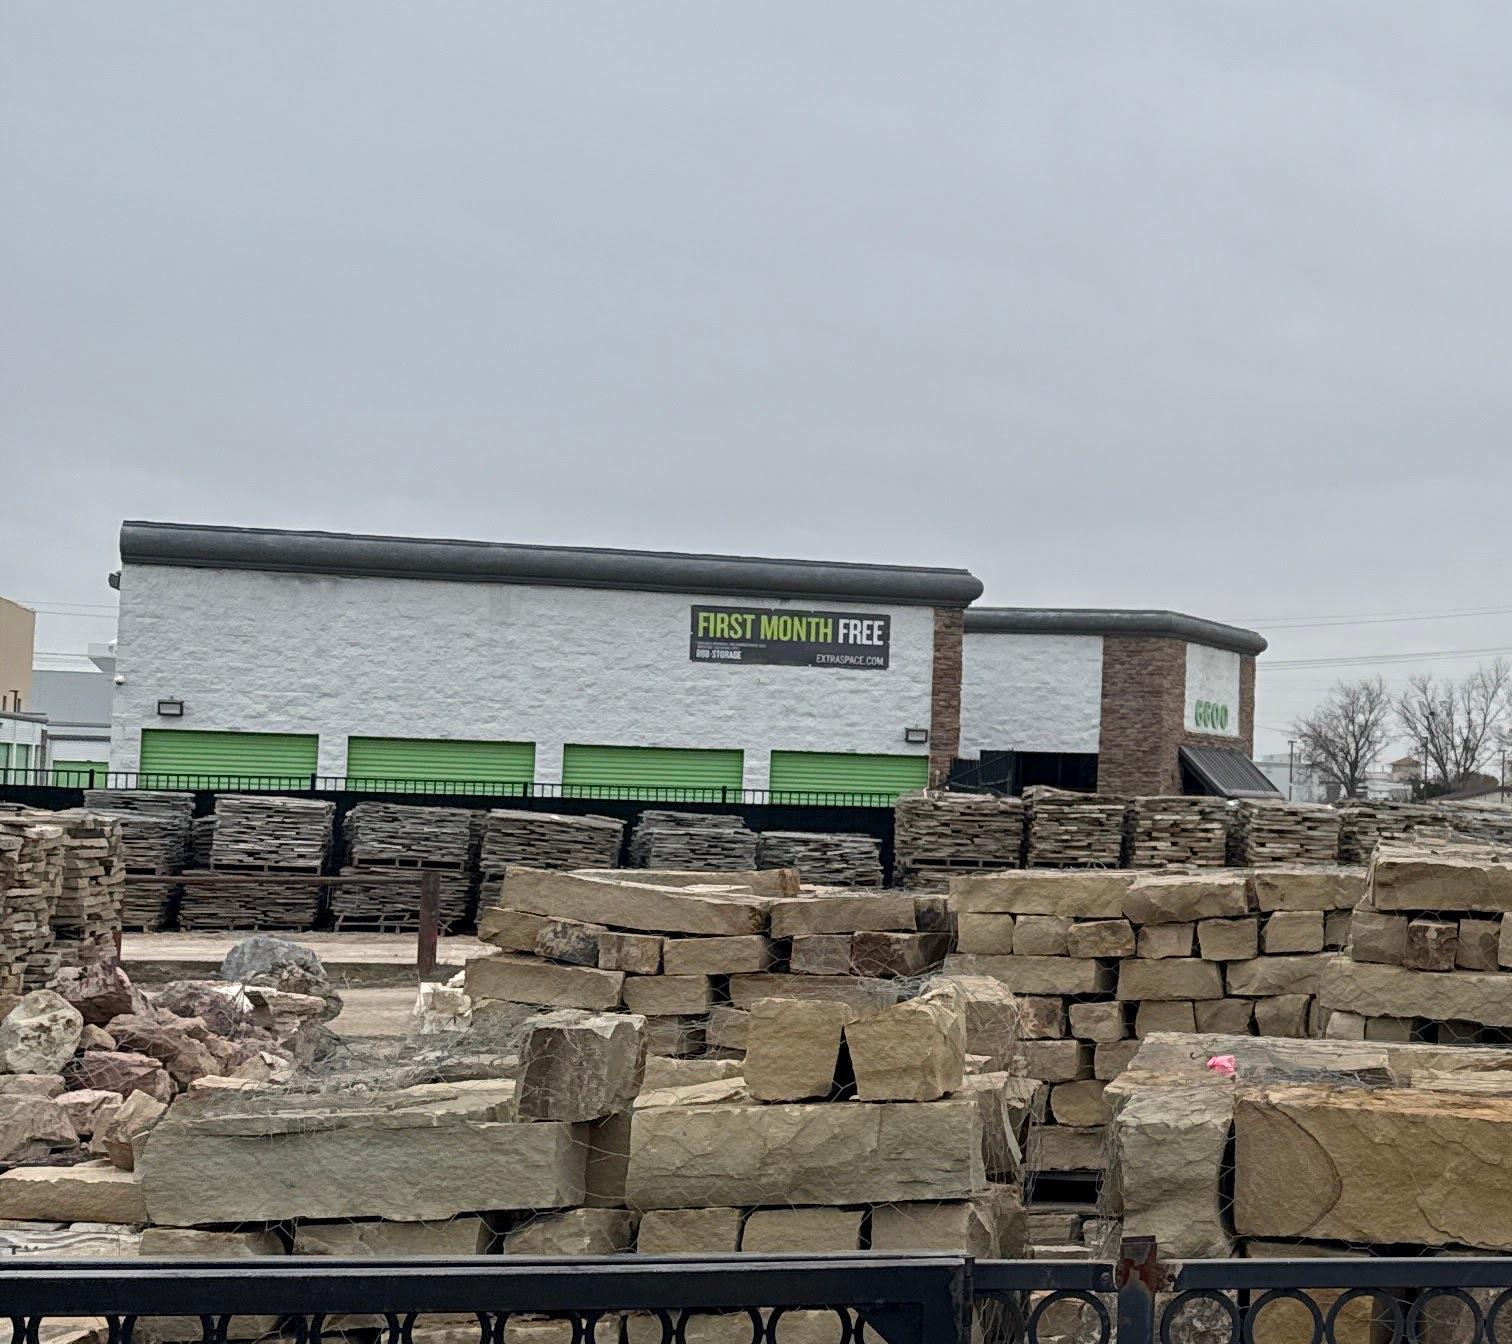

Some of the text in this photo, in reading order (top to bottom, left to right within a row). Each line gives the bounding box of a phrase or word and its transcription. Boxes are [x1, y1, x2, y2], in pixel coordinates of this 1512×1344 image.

[697, 611, 885, 646] FIRST MONTH FREE
[816, 653, 884, 666] EXTRASPACE.COM
